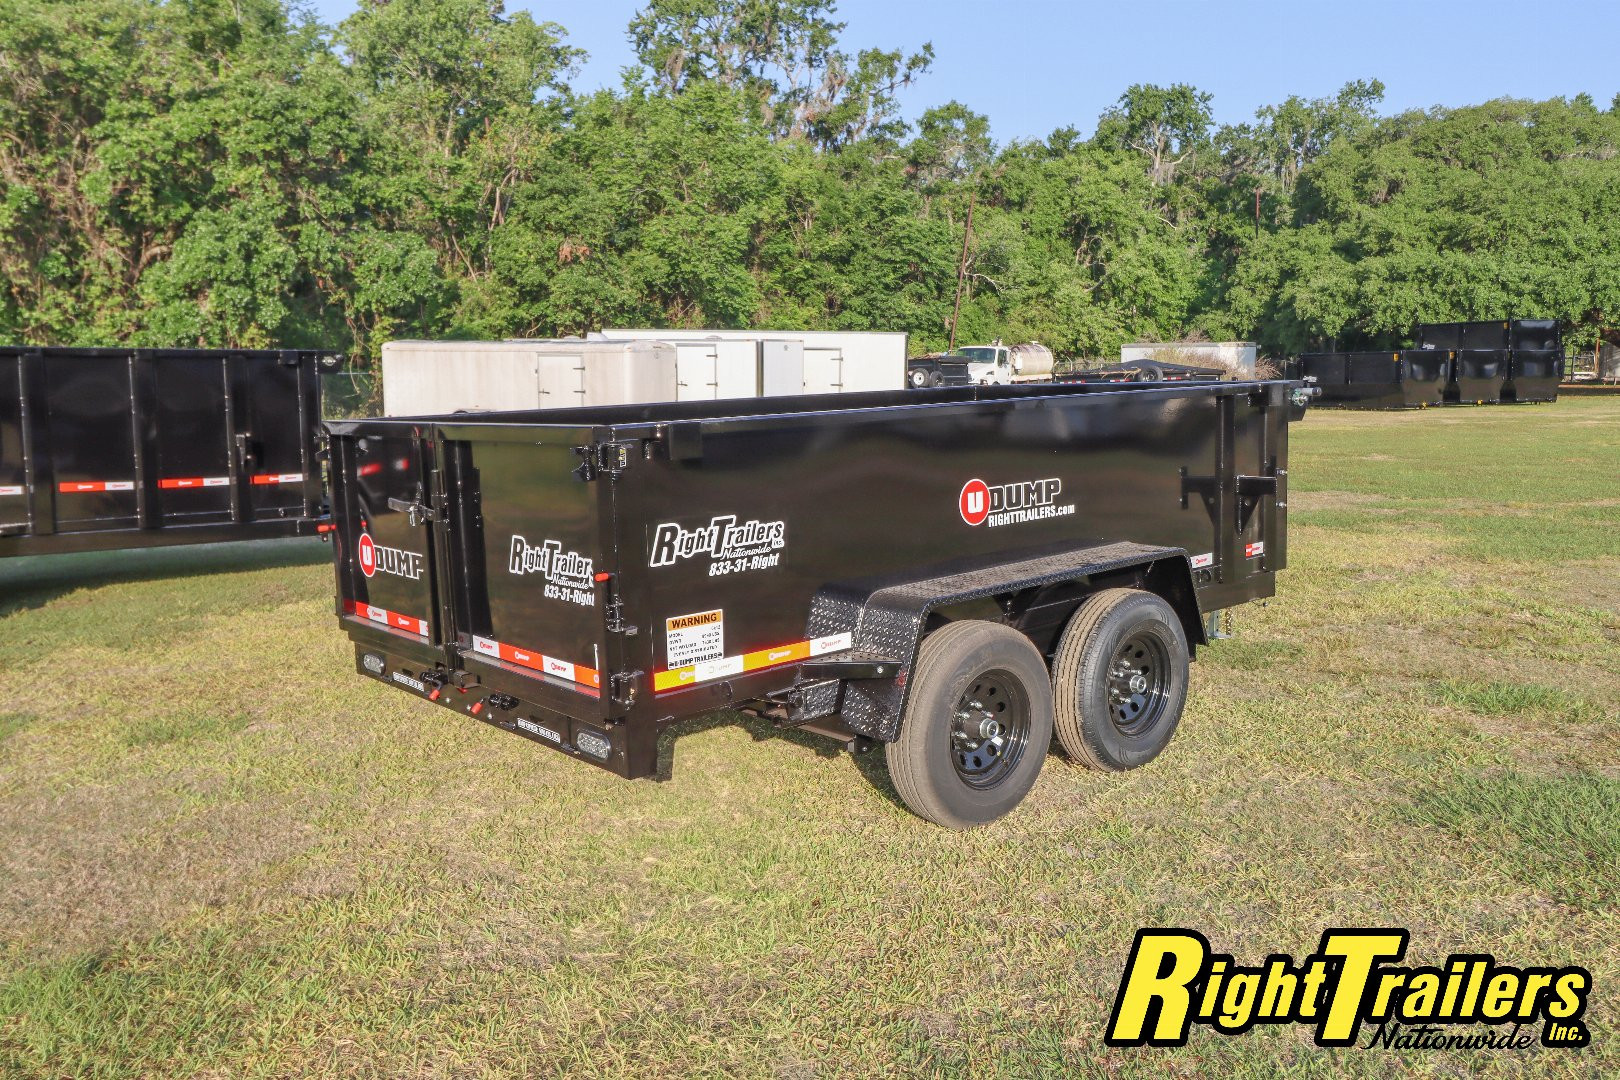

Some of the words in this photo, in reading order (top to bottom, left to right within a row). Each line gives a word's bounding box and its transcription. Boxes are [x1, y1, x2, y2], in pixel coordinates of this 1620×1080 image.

[988, 504, 1076, 528] RIGHTTRAILERS.com
[719, 542, 773, 561] Nationwide
[708, 552, 780, 577] 833-31-Right
[671, 612, 718, 629] WARNING
